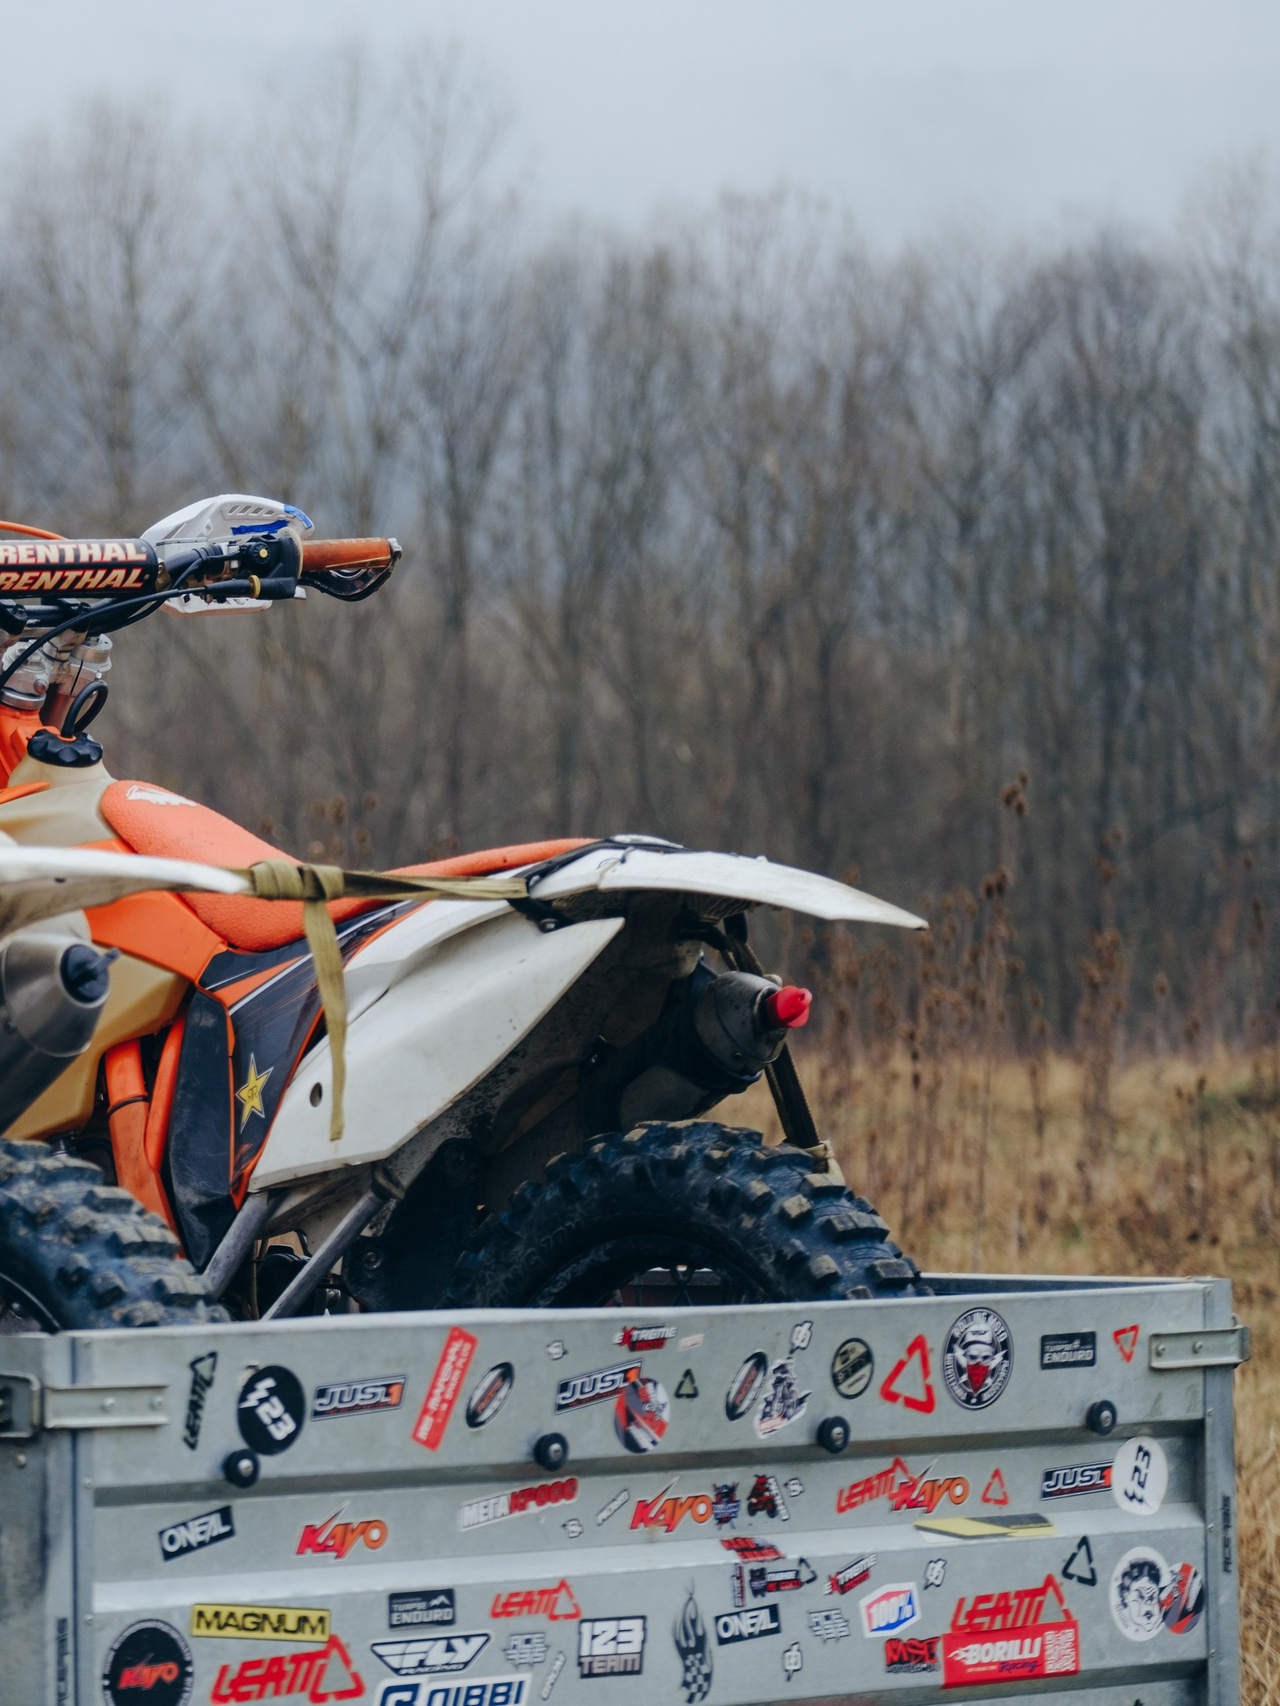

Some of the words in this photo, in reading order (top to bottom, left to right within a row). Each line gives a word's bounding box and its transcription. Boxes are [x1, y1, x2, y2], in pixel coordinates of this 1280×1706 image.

[613, 1326, 678, 1347] EXTREME
[952, 1312, 987, 1338] ROLLING
[1042, 1350, 1094, 1364] ENDURO
[891, 1459, 969, 1514] KAYO
[629, 1477, 713, 1533] KAYO
[295, 1502, 388, 1560] KAYO
[824, 1553, 878, 1595] EXTREME
[392, 1602, 428, 1611] TUAPSE
[490, 1579, 582, 1621] LEATT
[869, 1592, 914, 1628] 100%
[195, 1610, 327, 1636] MAGNUM
[391, 1608, 454, 1625] ENDURO
[375, 1634, 489, 1669] FLY
[580, 1618, 645, 1656] 123
[962, 1636, 1043, 1665] BORILLI
[117, 1654, 179, 1690] KAYO
[211, 1635, 366, 1704] LEATT
[399, 1663, 465, 1675] RACING
[580, 1653, 641, 1675] TEAM
[999, 1661, 1039, 1673] Racing
